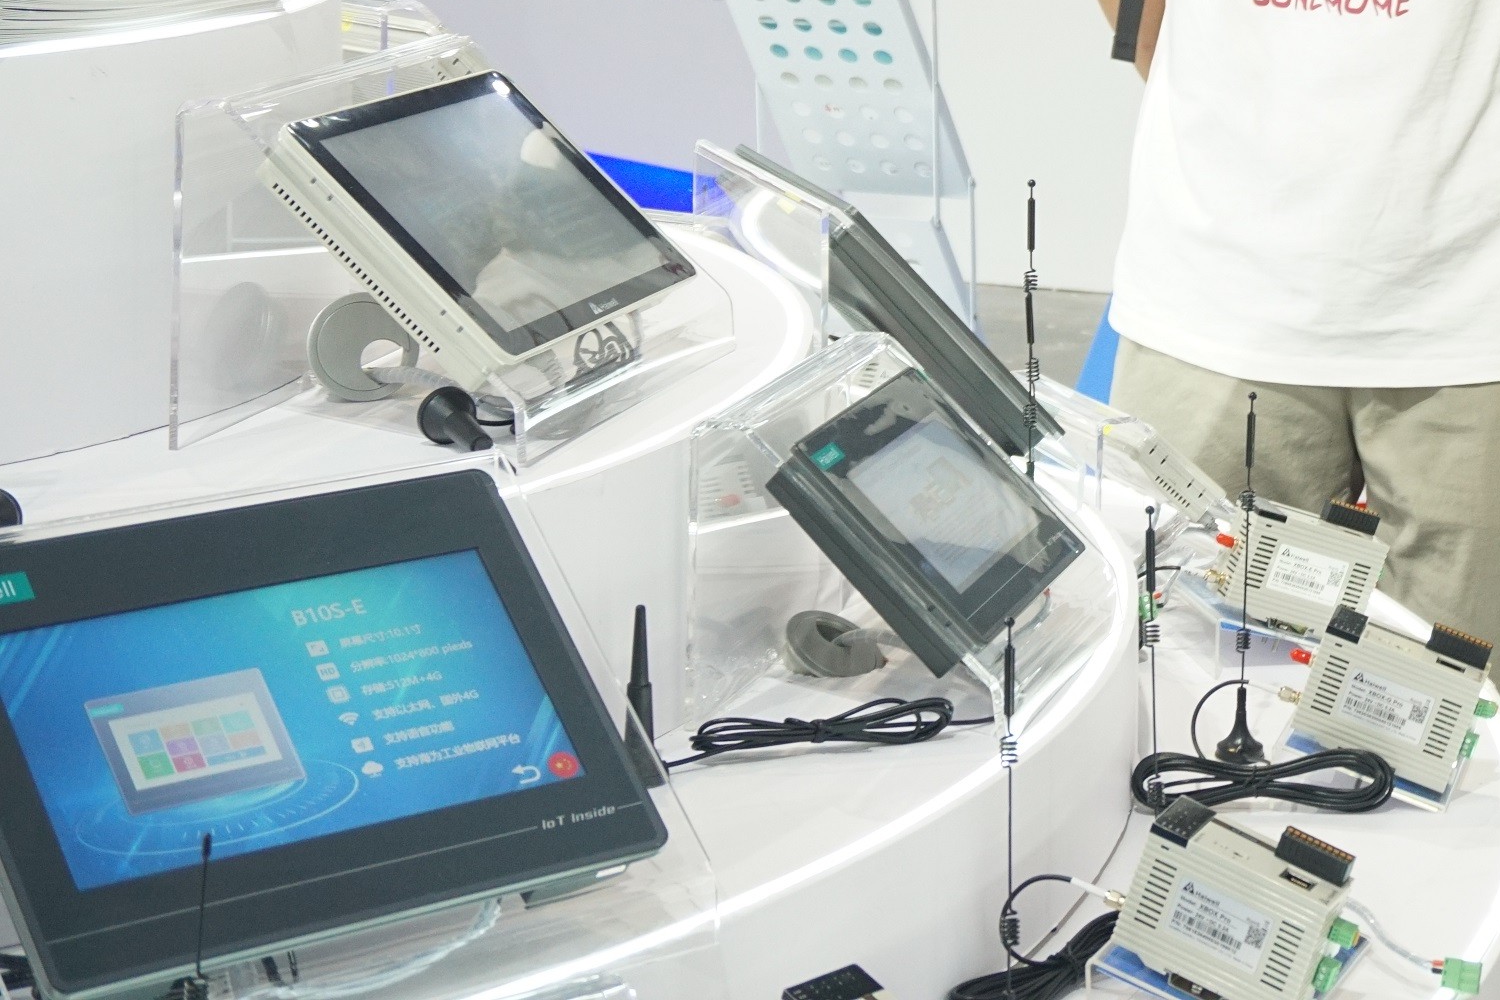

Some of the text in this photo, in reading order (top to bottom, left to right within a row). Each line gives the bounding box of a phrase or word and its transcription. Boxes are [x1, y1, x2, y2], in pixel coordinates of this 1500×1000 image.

[290, 598, 367, 626] B10S-E
[542, 805, 616, 830] IoT Inside
